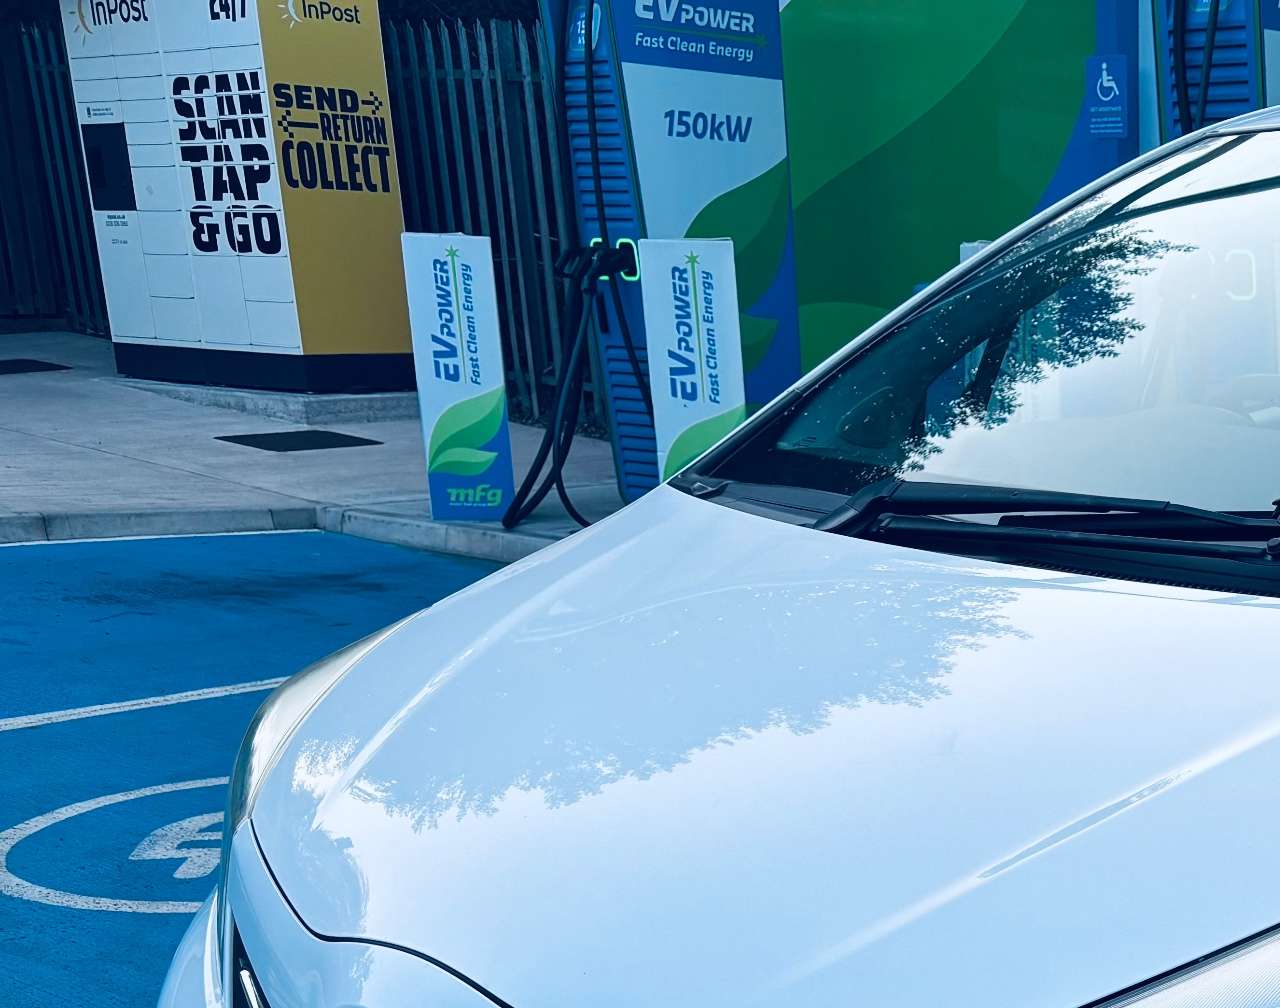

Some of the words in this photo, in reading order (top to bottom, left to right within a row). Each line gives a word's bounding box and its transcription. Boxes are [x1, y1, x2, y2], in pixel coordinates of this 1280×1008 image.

[91, 0, 148, 25] InPost
[301, 0, 361, 25] InPost
[635, 32, 664, 48] Fast
[667, 36, 705, 54] Clean
[709, 39, 754, 62] Energy
[172, 71, 267, 141] SCAN
[273, 83, 359, 114] SEND
[319, 112, 388, 145] RETURN
[664, 109, 752, 143] 150kW
[180, 143, 271, 201] TAP
[282, 140, 390, 192] COLLECT
[189, 205, 220, 253] &
[224, 204, 282, 255] GO
[461, 263, 474, 312] Energy
[701, 270, 714, 324] Energy
[467, 315, 478, 354] Clean
[705, 328, 718, 370] Clean
[470, 357, 482, 386] Fast
[709, 373, 720, 404] Fast
[447, 484, 502, 506] mfg
